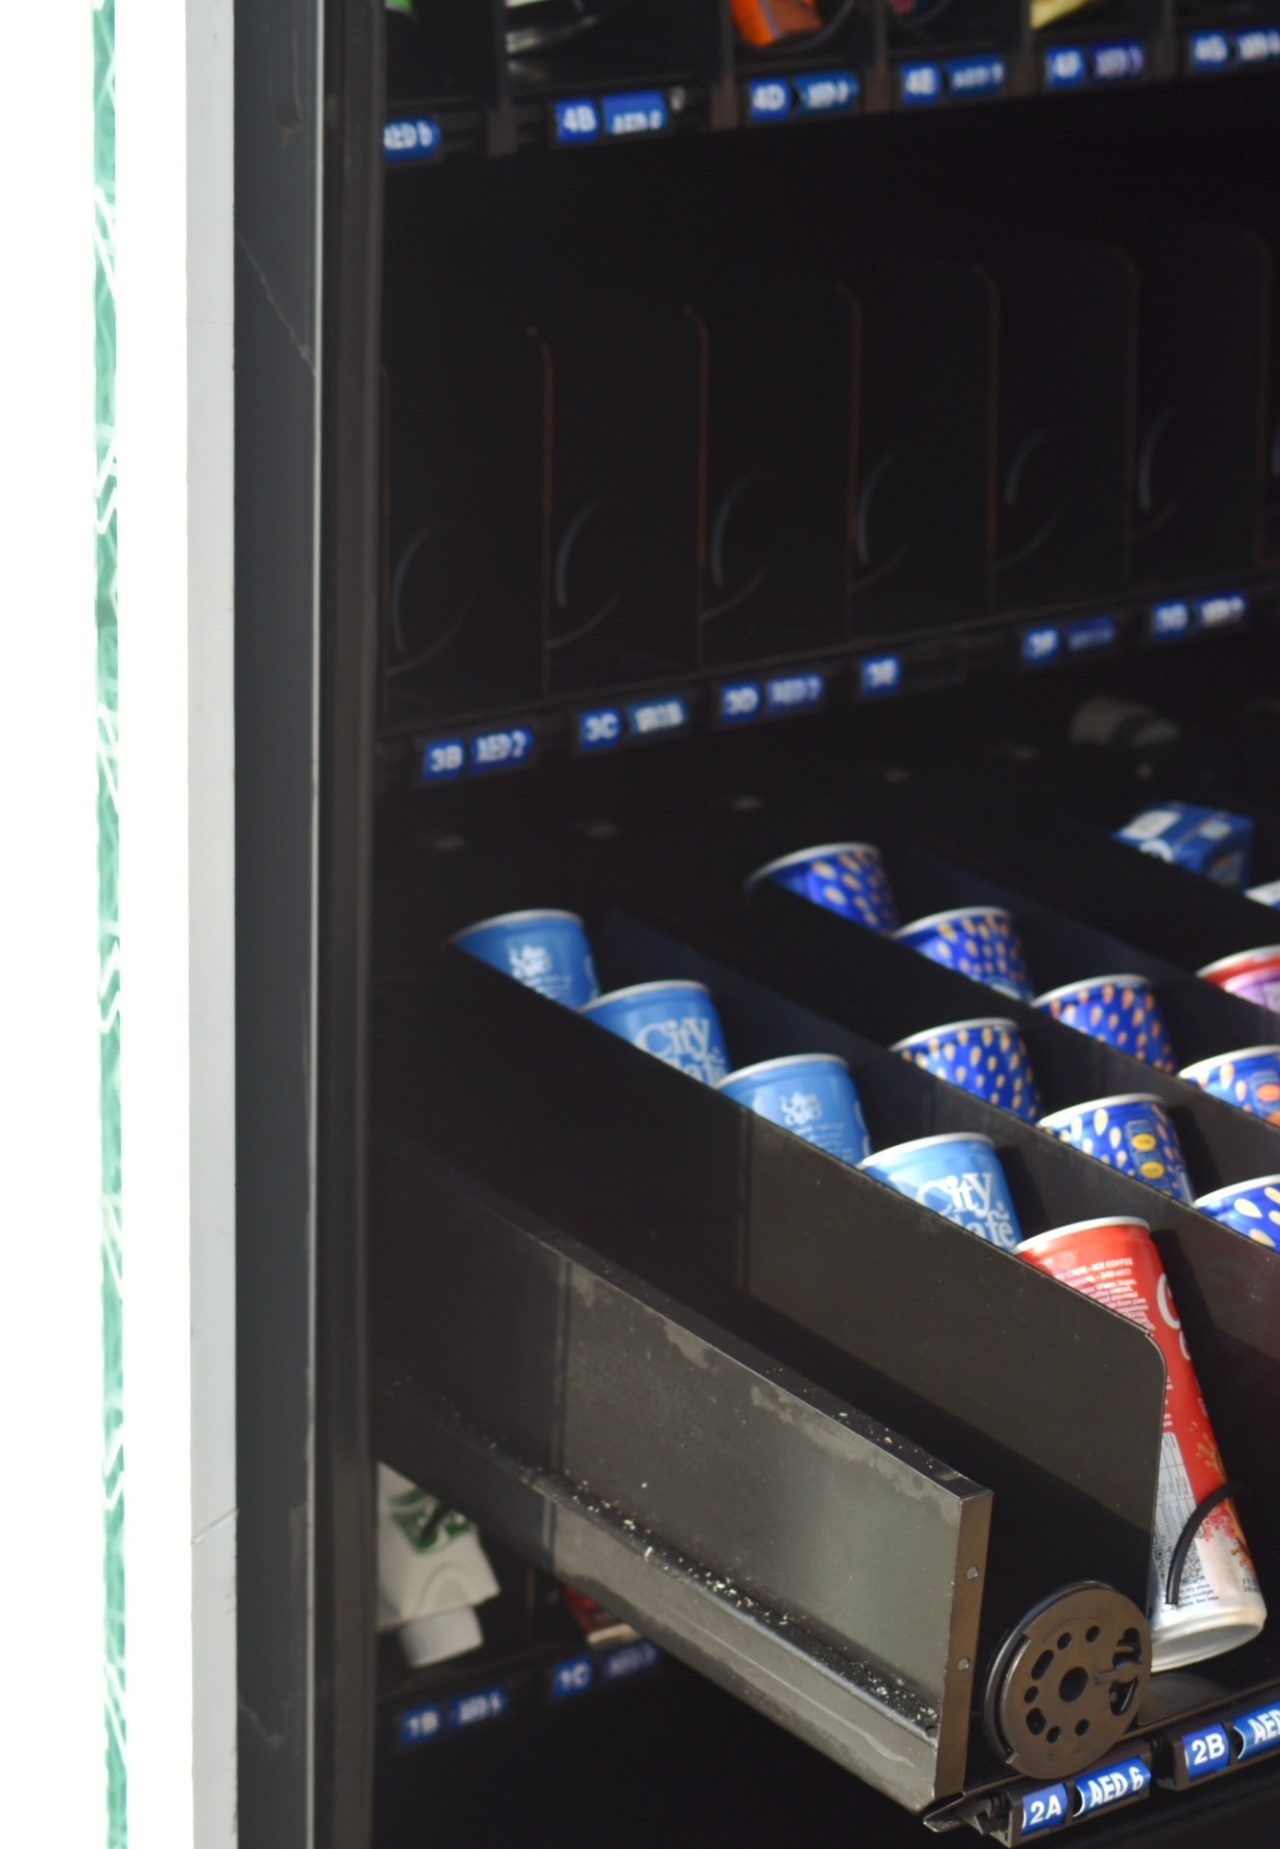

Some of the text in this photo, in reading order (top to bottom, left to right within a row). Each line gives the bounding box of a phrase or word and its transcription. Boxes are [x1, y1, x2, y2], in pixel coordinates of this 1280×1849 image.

[564, 105, 596, 132] 4B
[585, 713, 618, 742] 3C
[430, 744, 463, 772] 3B
[916, 1172, 993, 1218] City
[1192, 1733, 1226, 1765] 2B
[1030, 1794, 1062, 1825] 2A
[1089, 1775, 1129, 1807] AED
